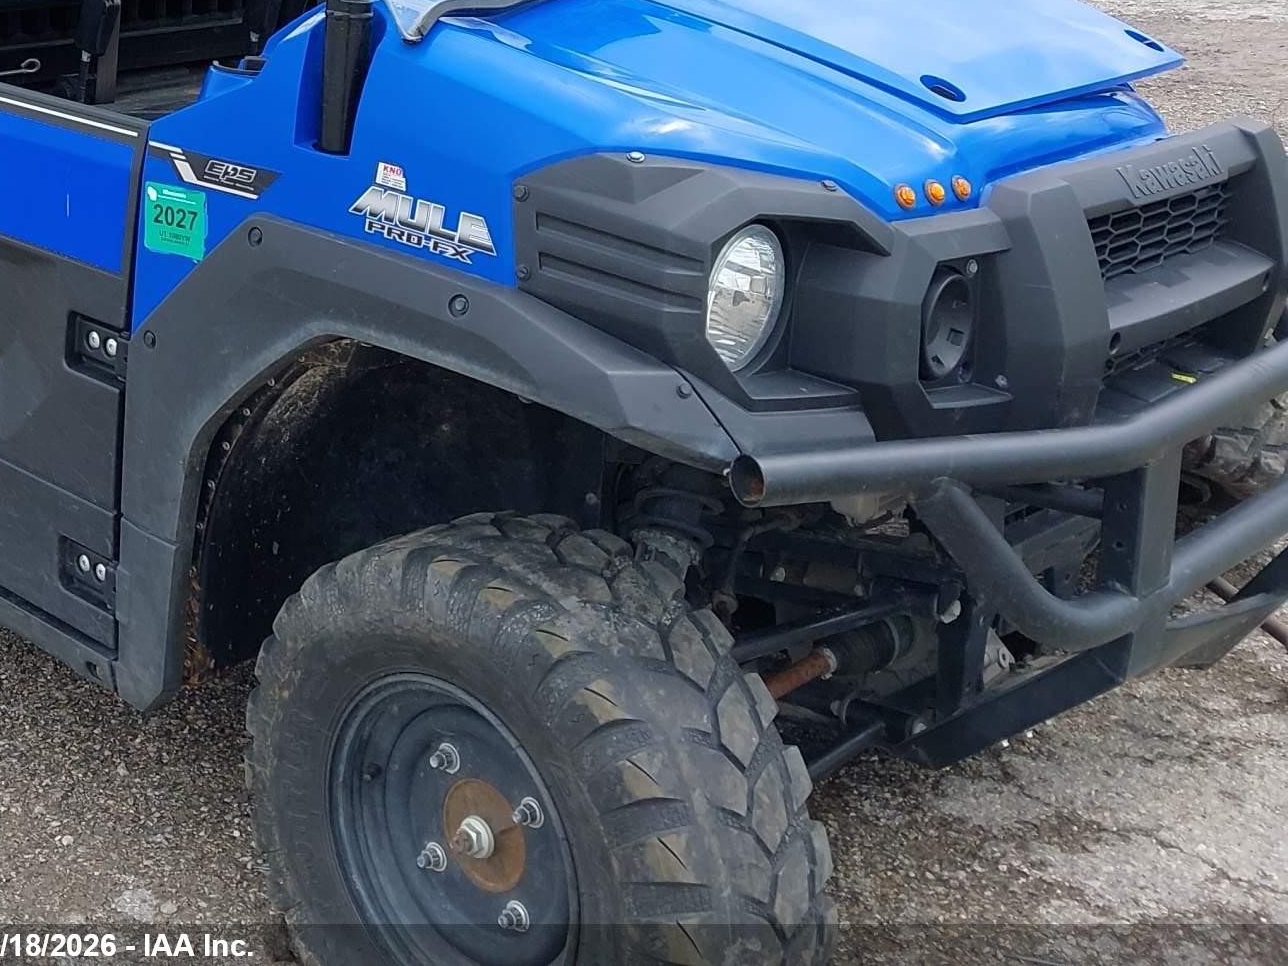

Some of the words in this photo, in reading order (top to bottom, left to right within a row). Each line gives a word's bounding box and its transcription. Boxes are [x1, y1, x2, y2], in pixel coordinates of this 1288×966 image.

[205, 160, 257, 183] EPS
[1116, 144, 1224, 199] Kawasaki
[153, 203, 198, 231] 2027
[348, 186, 497, 256] MULE
